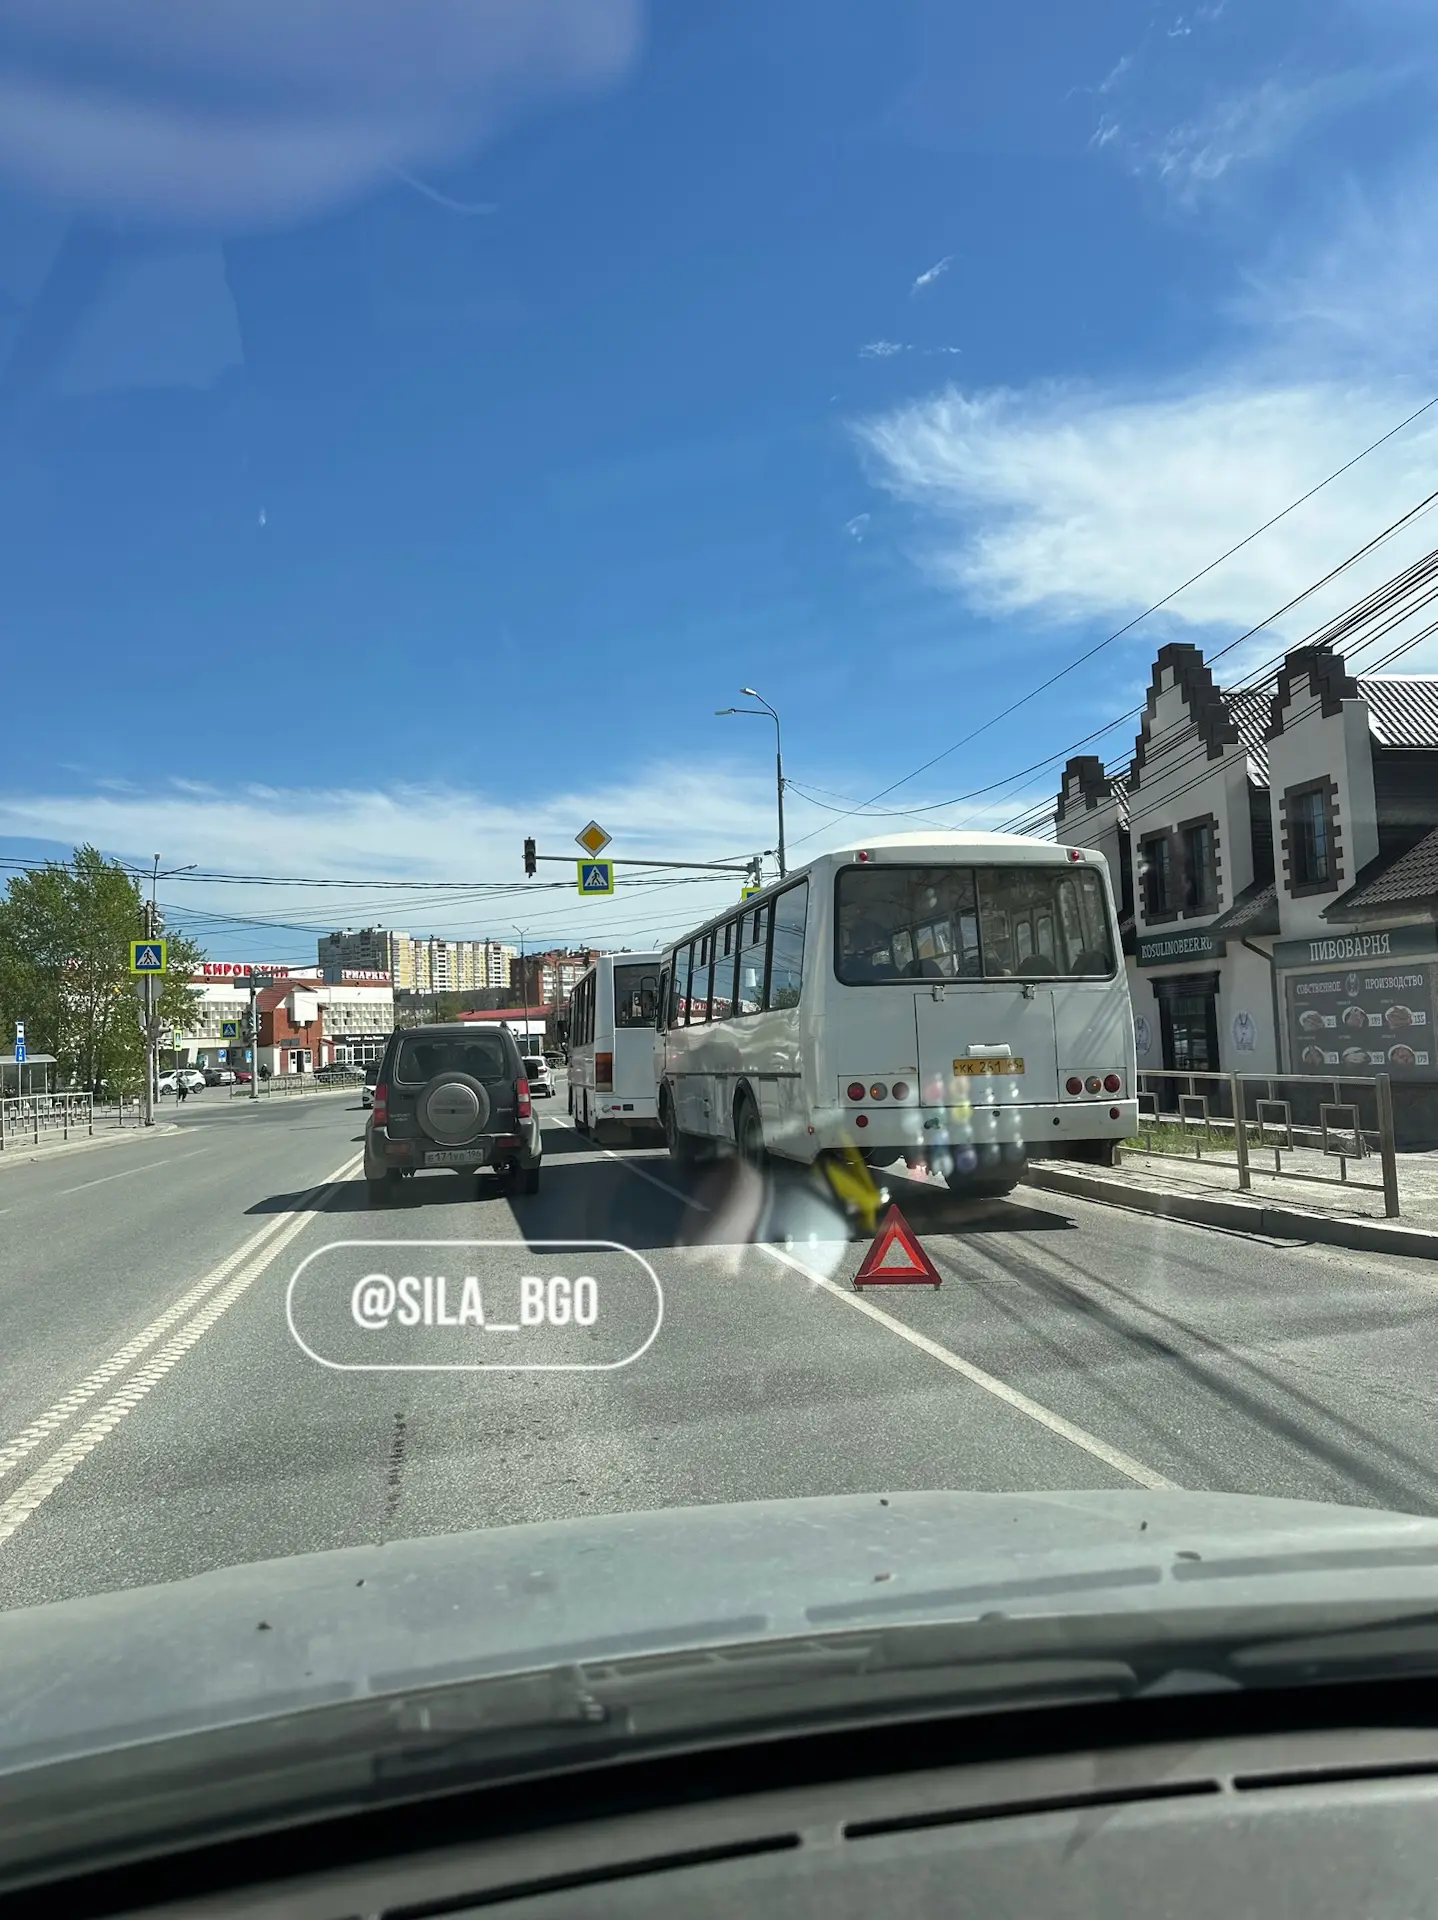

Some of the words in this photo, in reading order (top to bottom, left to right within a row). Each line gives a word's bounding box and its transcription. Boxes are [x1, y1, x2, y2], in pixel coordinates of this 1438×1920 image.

[1309, 933, 1391, 961] ПИВОВАРНЯ
[1296, 981, 1342, 994] СОБСТВЕННОЕ
[1365, 974, 1423, 990] ПРОИЗВОДСТВО
